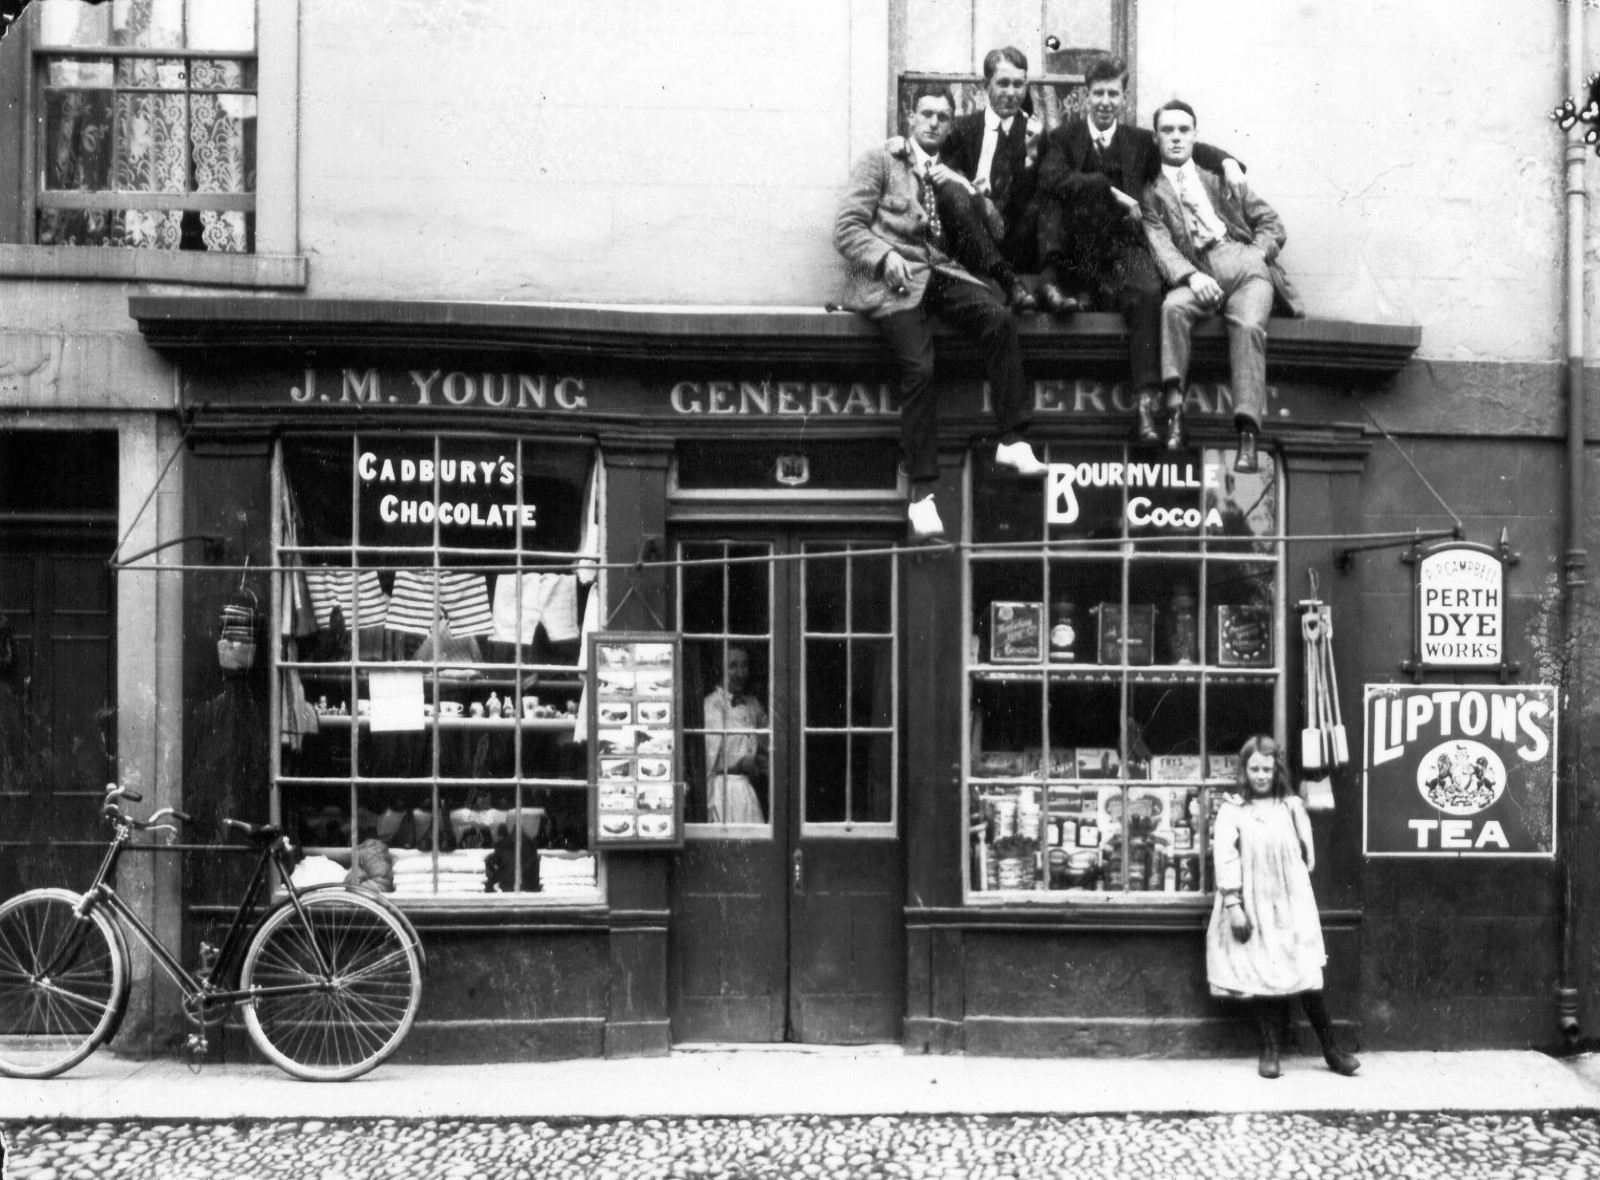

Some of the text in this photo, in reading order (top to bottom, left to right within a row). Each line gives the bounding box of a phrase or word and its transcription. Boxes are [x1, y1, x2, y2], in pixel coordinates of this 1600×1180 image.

[408, 369, 588, 410] YOUNG
[670, 381, 902, 415] GENERAL
[358, 452, 515, 485] CADBURY'S
[1047, 462, 1220, 524] BOURNVILLE
[379, 494, 537, 527] CHOCOLATE
[1126, 496, 1223, 528] COCOA
[1426, 588, 1498, 607] PERTH
[1428, 613, 1496, 637] DYE
[1425, 642, 1498, 658] WORKS
[1373, 690, 1550, 767] LIPTON'S
[1408, 819, 1510, 849] TEA
